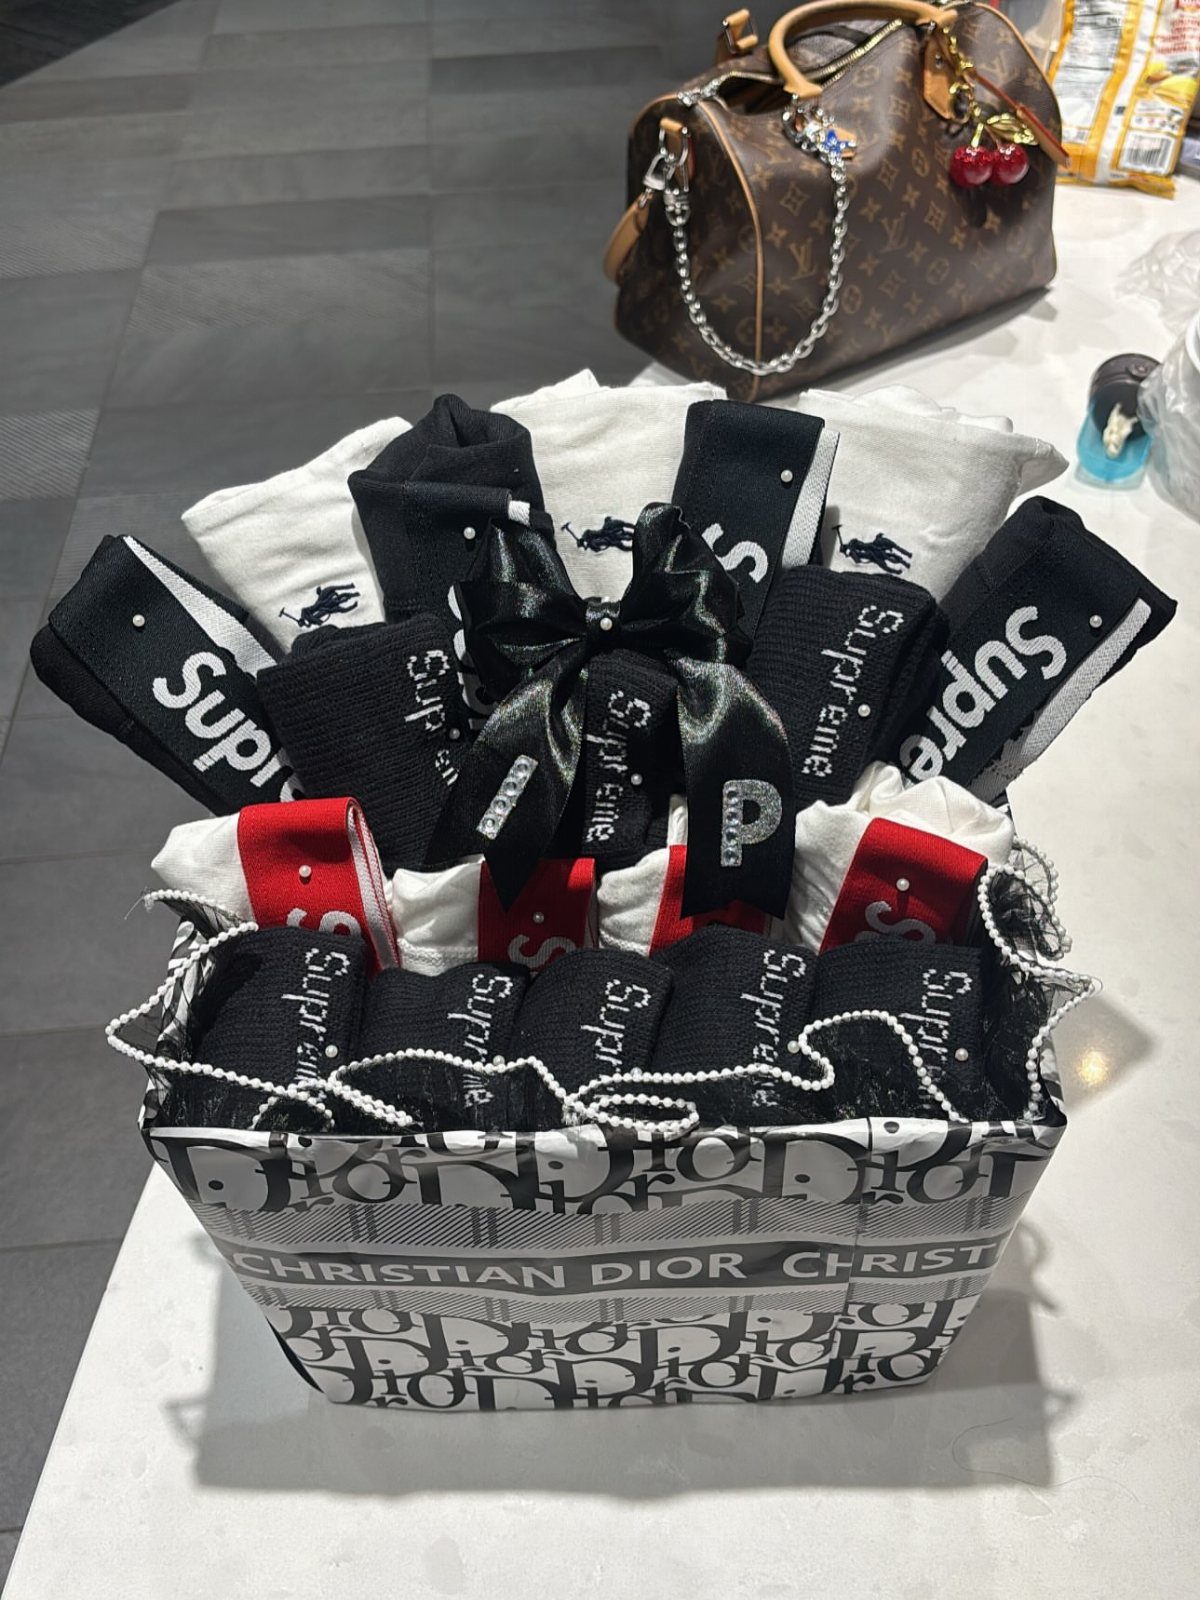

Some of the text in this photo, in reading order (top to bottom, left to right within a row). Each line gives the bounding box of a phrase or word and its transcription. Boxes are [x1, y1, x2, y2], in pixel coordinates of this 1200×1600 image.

[820, 605, 904, 777] Supreme
[586, 691, 652, 842] Supreme
[720, 779, 782, 867] P
[232, 1243, 1003, 1288] CHRISTIAN DIOR CHRIST
